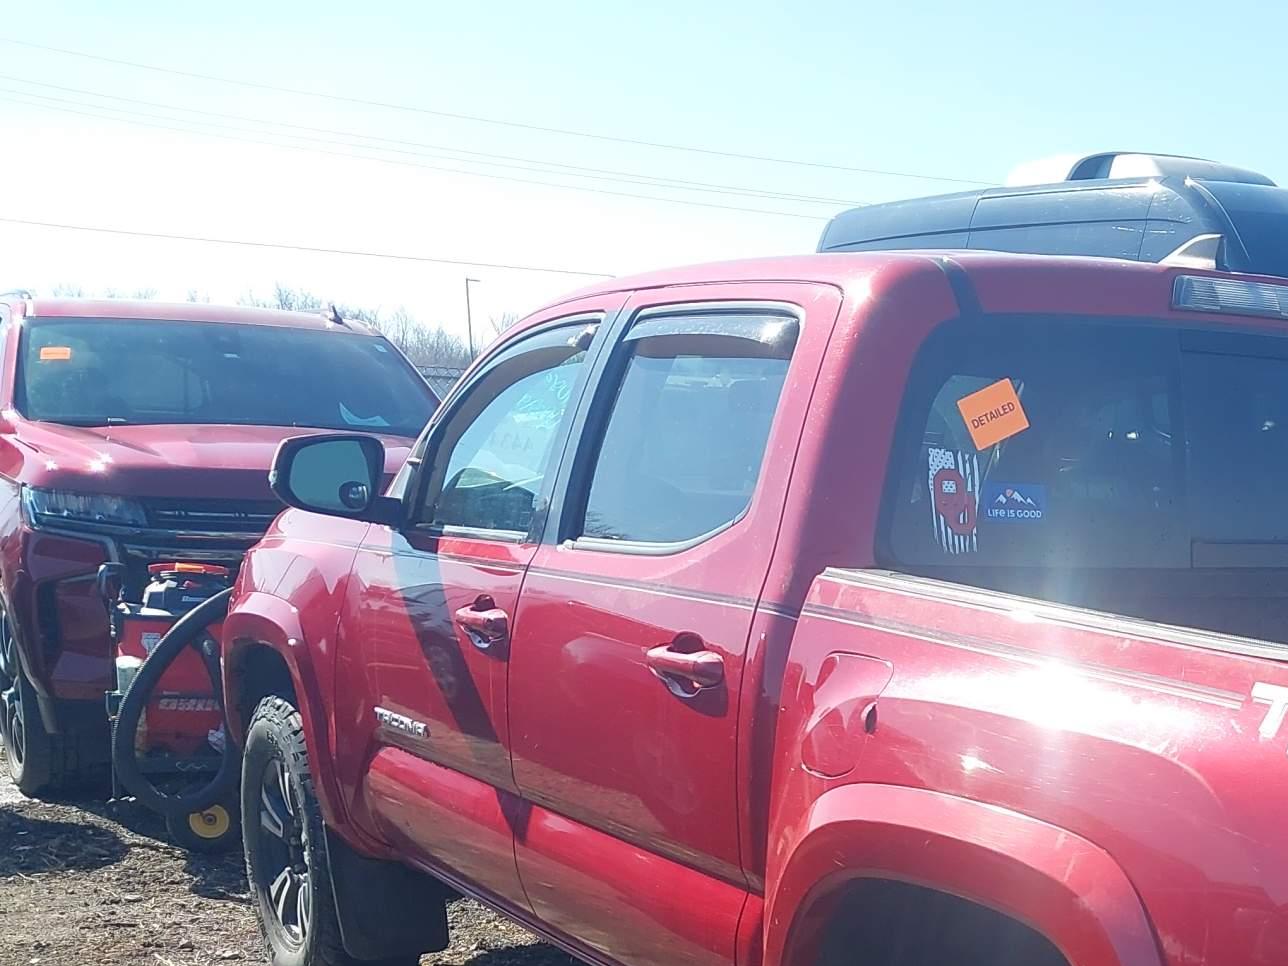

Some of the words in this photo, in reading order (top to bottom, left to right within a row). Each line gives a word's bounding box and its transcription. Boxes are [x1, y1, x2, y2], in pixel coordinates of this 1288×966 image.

[971, 402, 1015, 429] DETAILED
[1007, 509, 1015, 519] IS
[1016, 509, 1042, 519] GOOD
